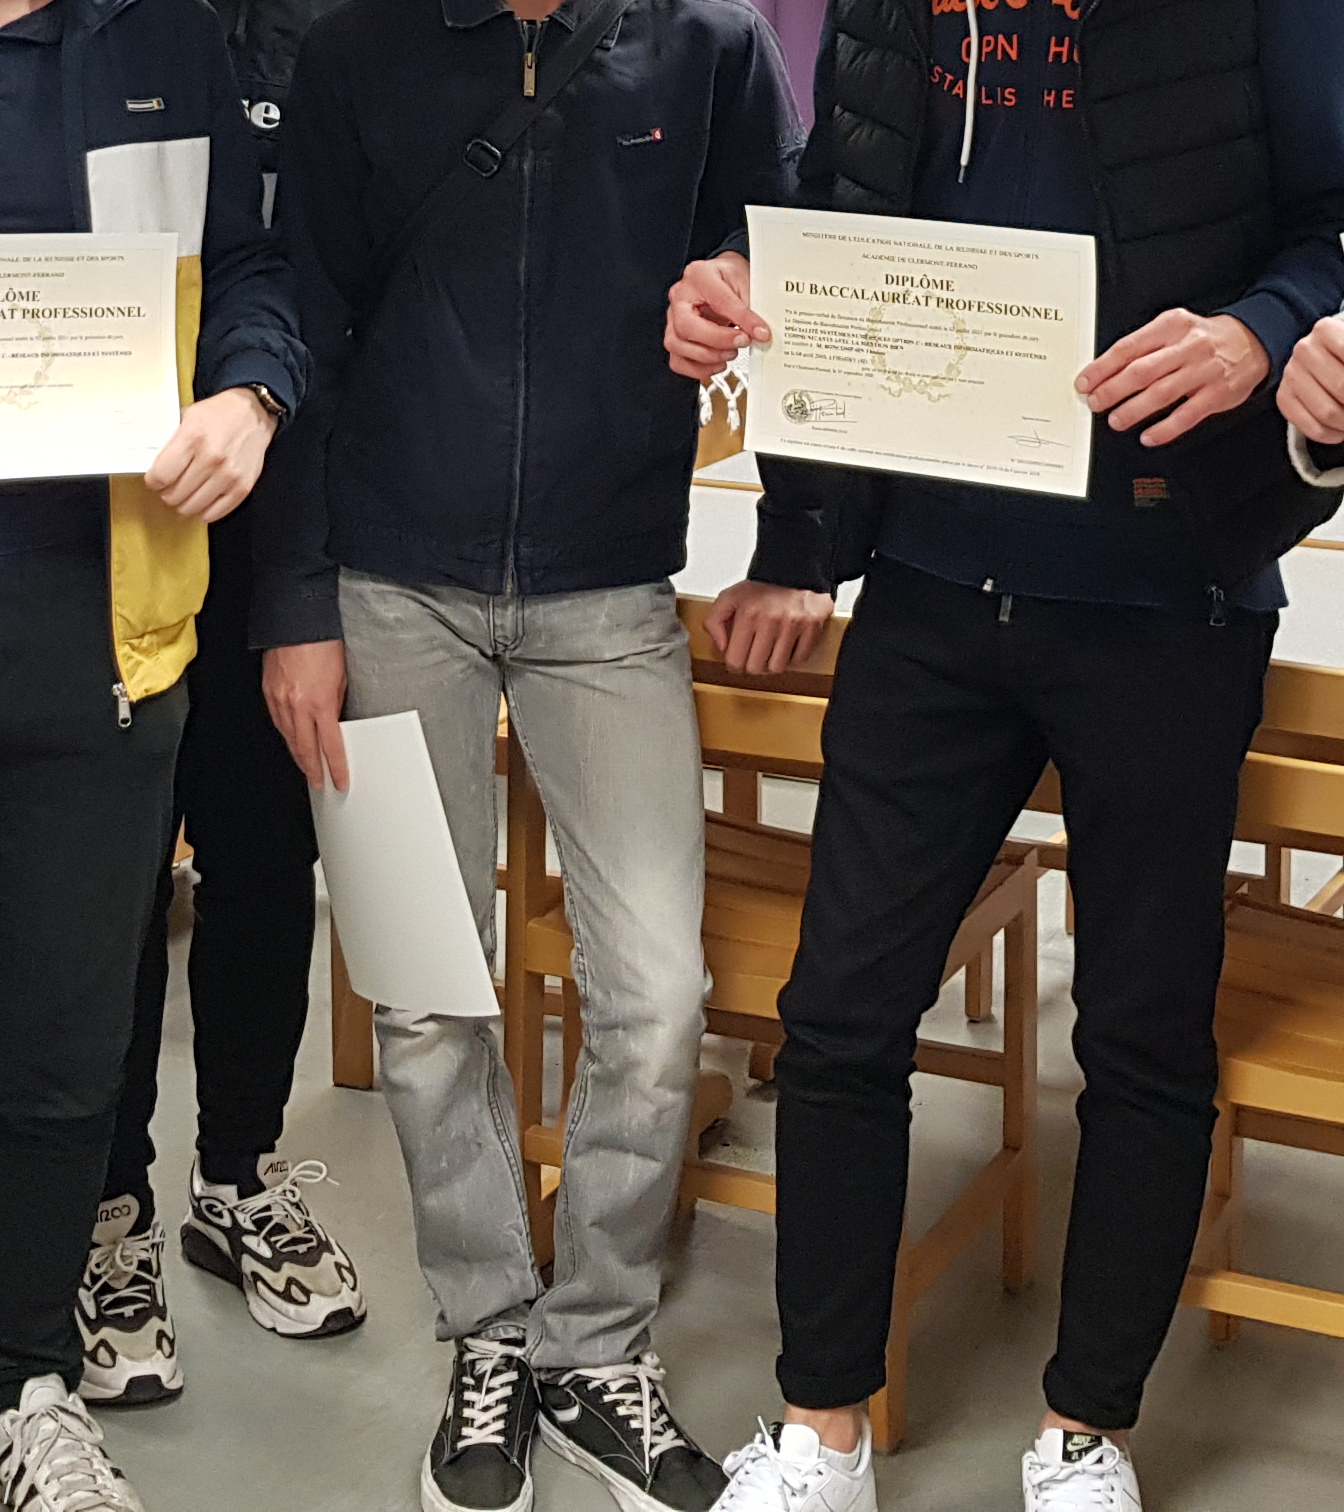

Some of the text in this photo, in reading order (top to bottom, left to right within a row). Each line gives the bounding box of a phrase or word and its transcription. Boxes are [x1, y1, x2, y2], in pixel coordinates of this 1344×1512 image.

[885, 273, 954, 291] DIPLÔME
[785, 280, 1063, 321] DU BACCALAURÉAT PROFESSIONNEL
[22, 306, 145, 319] PROFESSIONNEL
